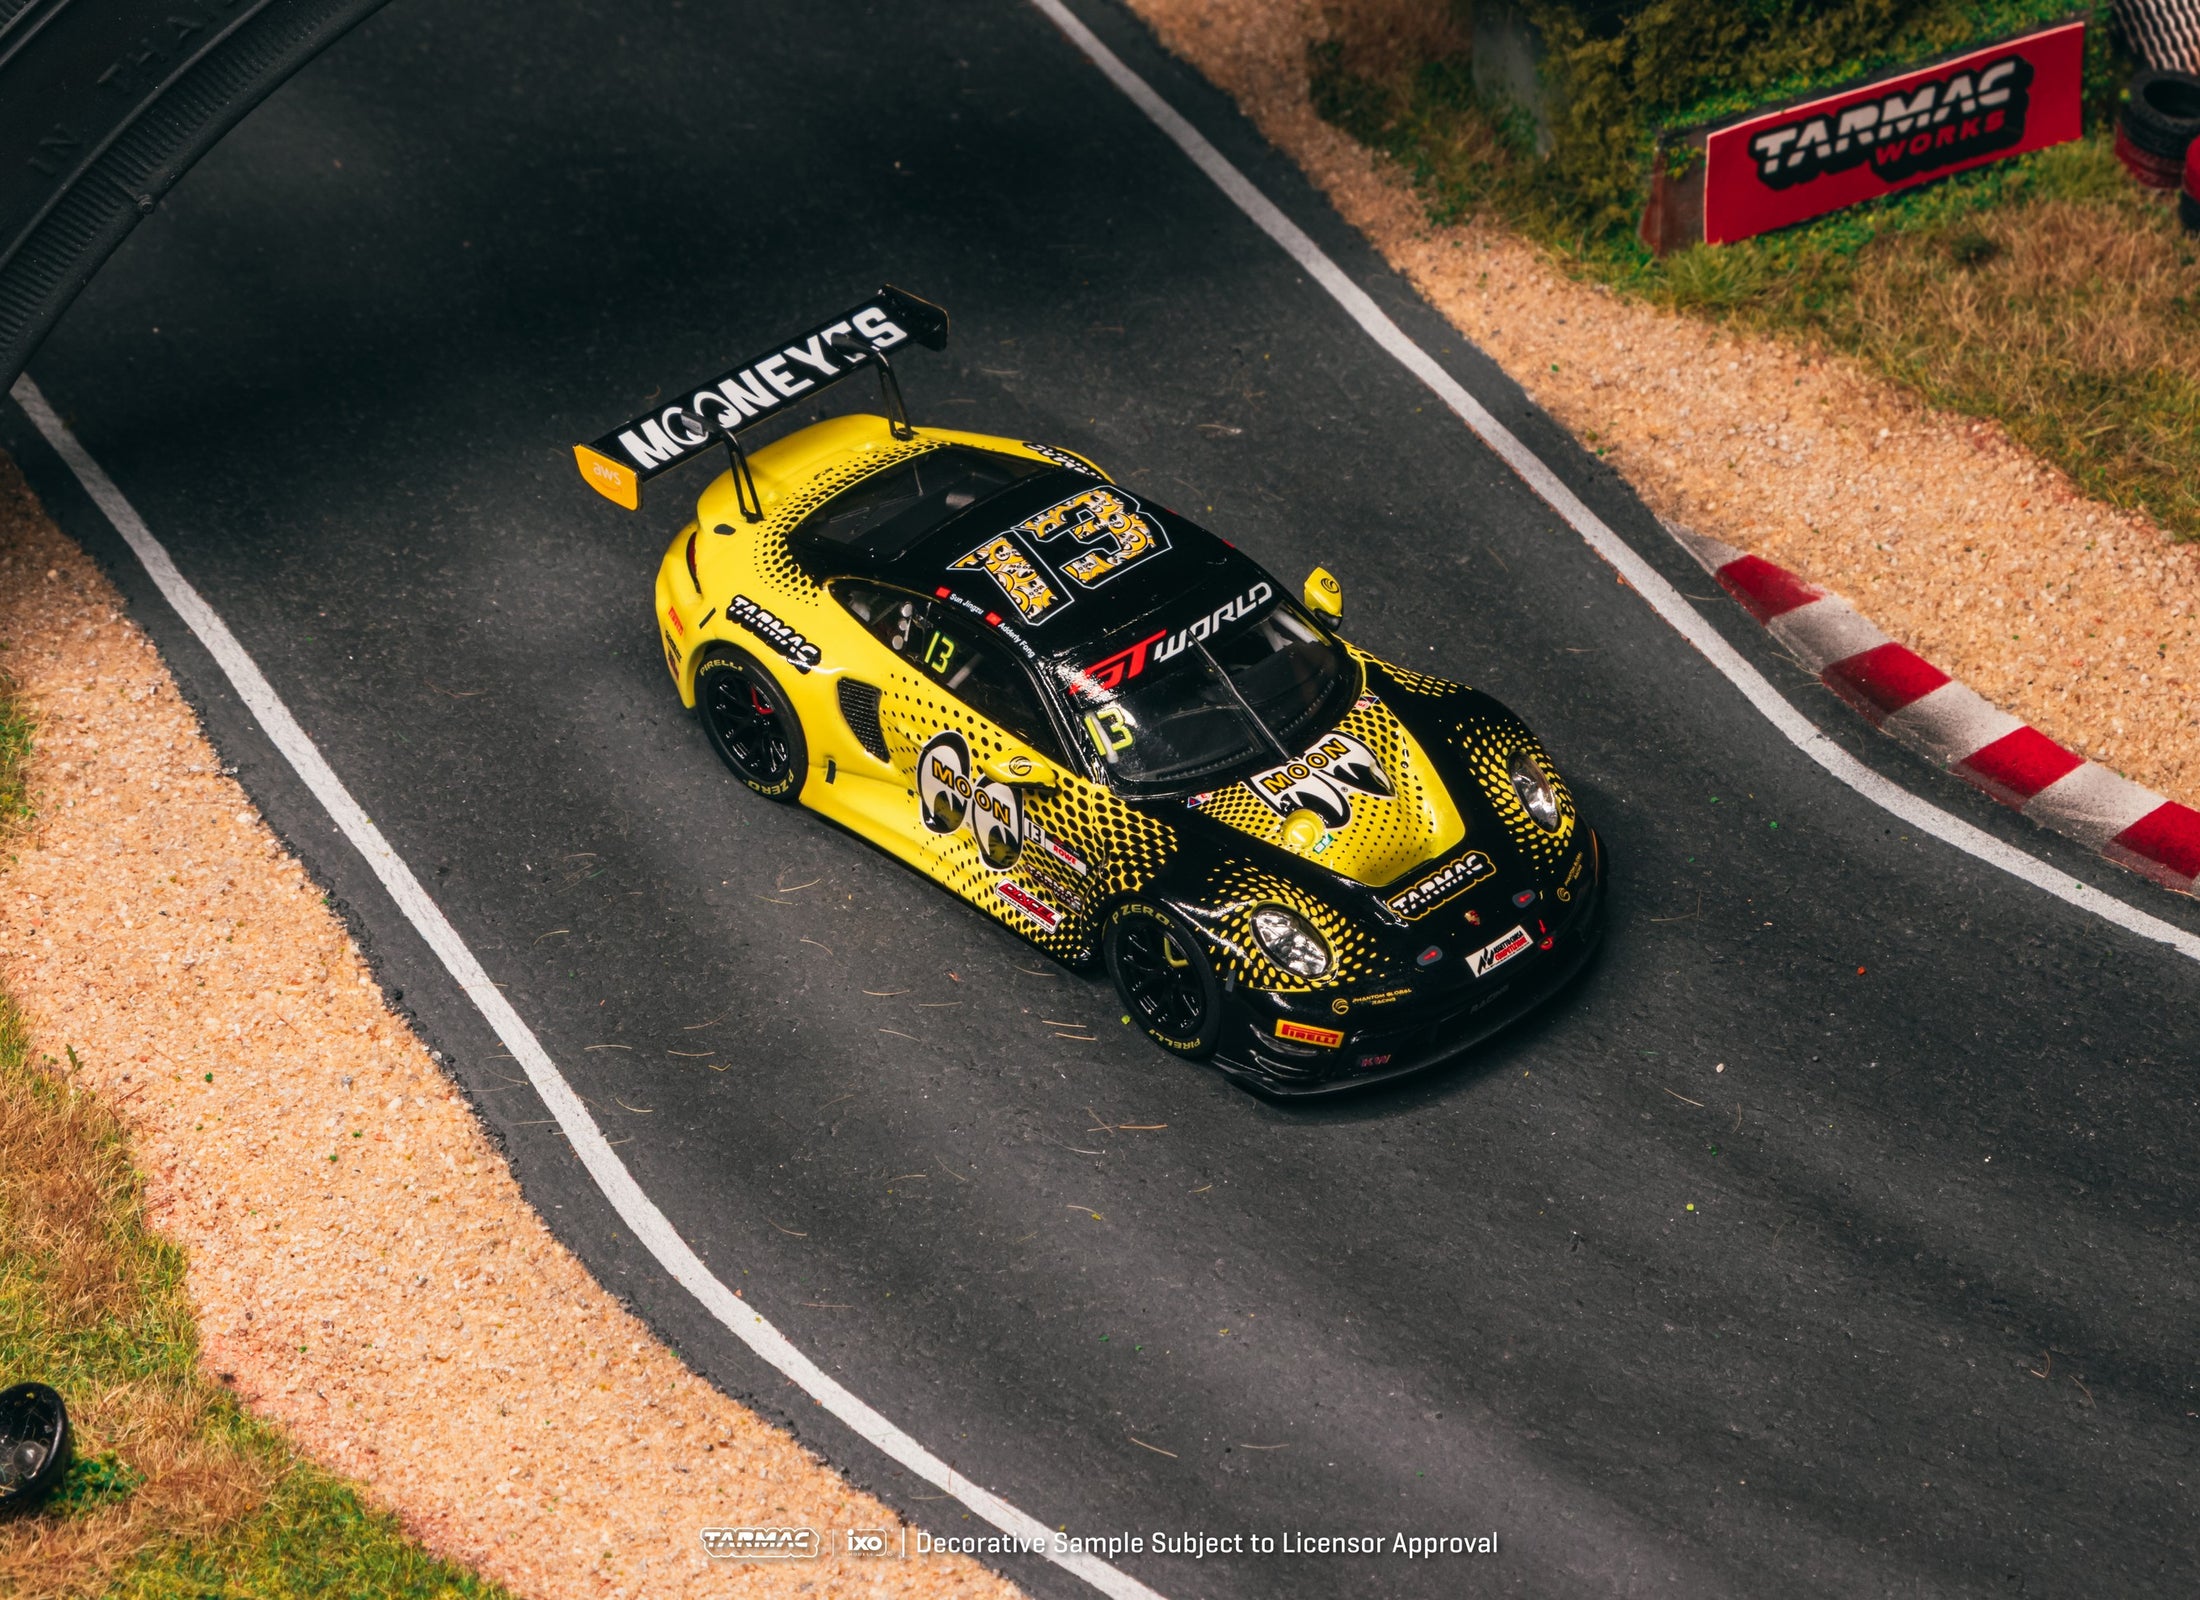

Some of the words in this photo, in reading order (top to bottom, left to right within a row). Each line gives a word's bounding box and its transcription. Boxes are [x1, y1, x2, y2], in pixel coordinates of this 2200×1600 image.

[1755, 61, 2017, 175] TARMAC
[1875, 109, 2006, 166] WORKS
[592, 462, 622, 487] aws
[946, 485, 1172, 626] 13
[949, 593, 963, 603] Sun
[728, 596, 818, 662] TARMAC
[997, 621, 1022, 643] Adderly
[1018, 639, 1036, 659] Fong
[1153, 581, 1273, 663] WORLD
[699, 658, 745, 677] PIRELLI
[924, 630, 955, 674] 13
[1084, 706, 1134, 756] 13
[747, 778, 790, 796] ZERO
[1258, 737, 1352, 796] MOON
[931, 755, 1011, 827] MOON
[1027, 821, 1042, 844] 13
[1053, 844, 1077, 866] ROWE
[1391, 854, 1484, 915] TARMAC
[1120, 903, 1170, 926] ZERO
[1148, 1028, 1202, 1050] PIRELLI
